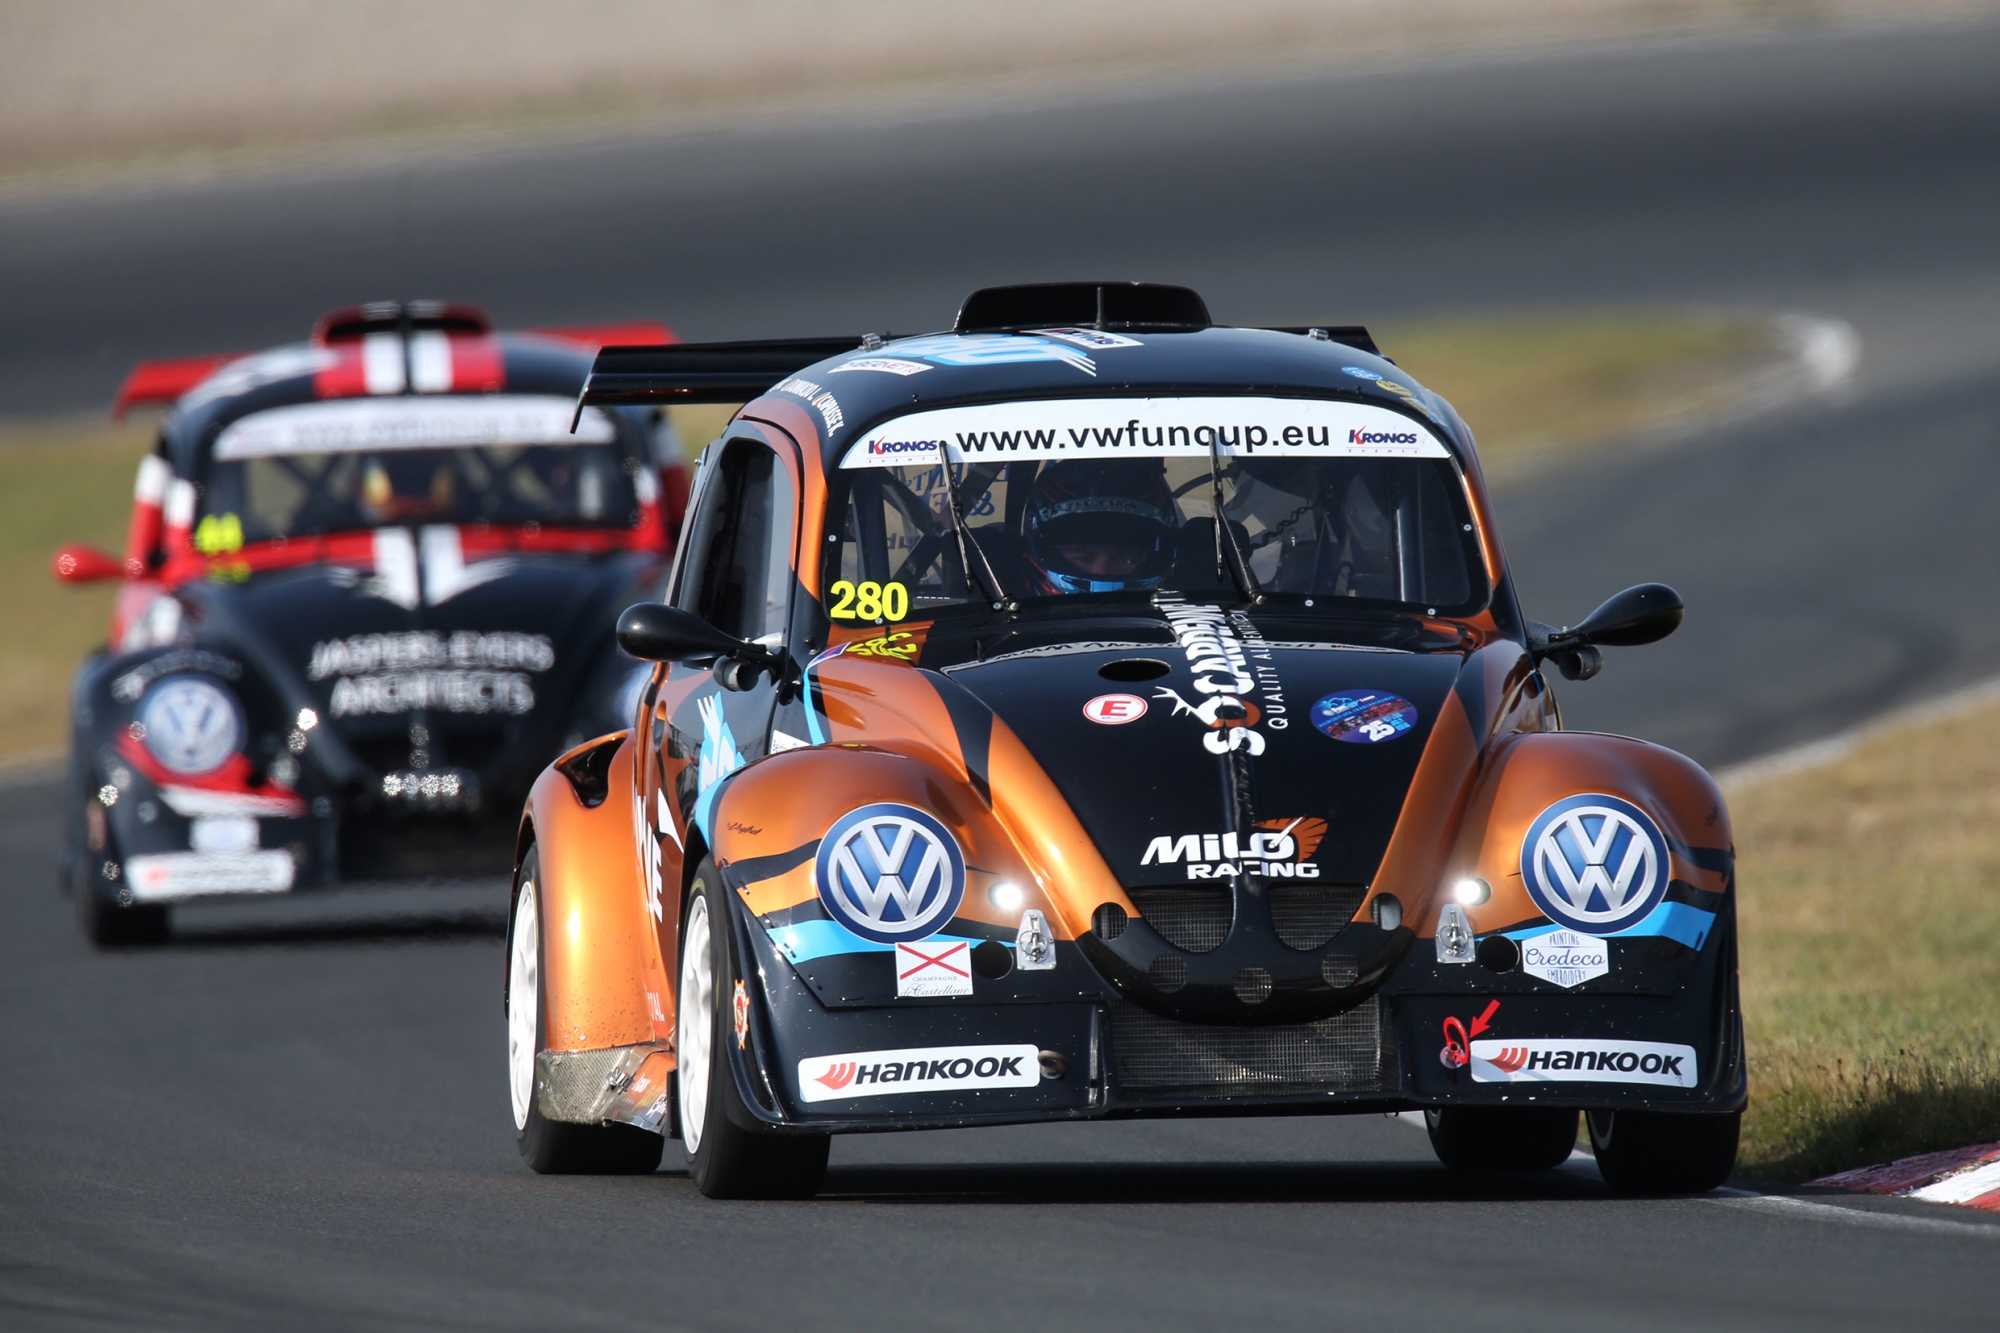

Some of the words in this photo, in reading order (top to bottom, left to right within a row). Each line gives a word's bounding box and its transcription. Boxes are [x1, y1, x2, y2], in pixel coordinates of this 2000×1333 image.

[869, 435, 938, 455] KRONOS
[956, 419, 1331, 453] www.vwfuncup.eu
[1348, 425, 1418, 445] KRONOS
[829, 580, 908, 621] 280
[1256, 665, 1288, 729] QUALITY
[1100, 701, 1131, 716] E
[1359, 719, 1396, 742] 25
[1187, 860, 1320, 880] RACING
[1549, 931, 1580, 946] PRINTING
[1525, 947, 1606, 967] Credeco
[911, 975, 958, 983] CHAMPAGNE
[1547, 969, 1586, 986] EMBROIDERY
